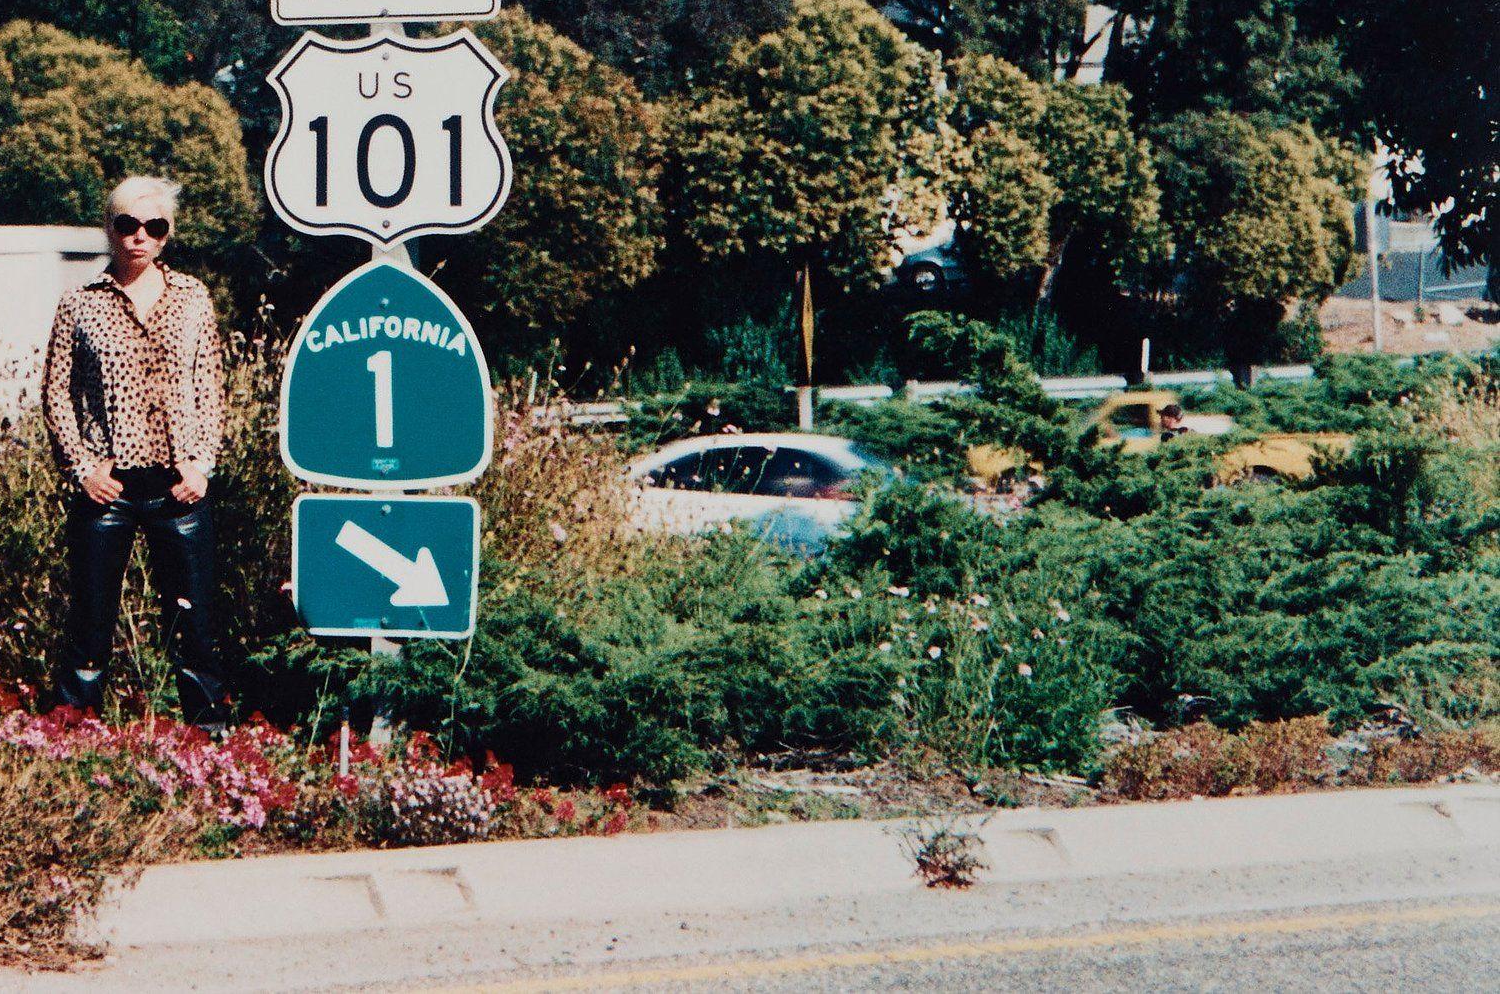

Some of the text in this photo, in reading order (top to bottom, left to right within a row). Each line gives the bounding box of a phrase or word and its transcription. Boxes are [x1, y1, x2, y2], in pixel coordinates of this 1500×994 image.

[358, 72, 412, 99] US
[308, 114, 462, 208] 101
[305, 315, 466, 357] CALIFORNIA
[366, 350, 394, 448] 1
